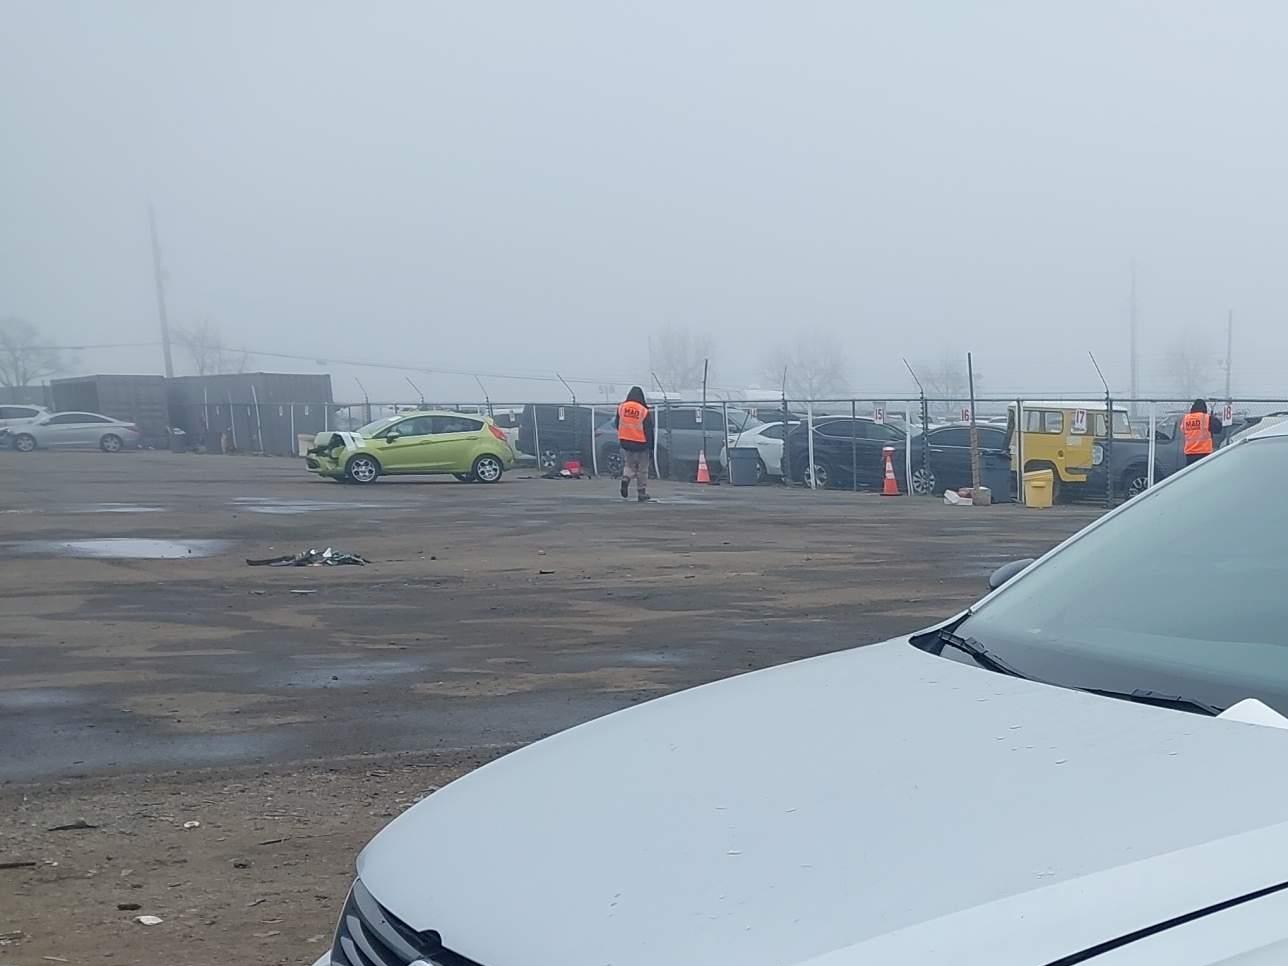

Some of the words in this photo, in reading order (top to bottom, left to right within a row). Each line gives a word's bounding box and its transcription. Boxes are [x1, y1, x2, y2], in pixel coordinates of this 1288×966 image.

[874, 408, 884, 421] 15
[960, 409, 969, 422] 16
[1075, 410, 1085, 422] 17
[1223, 405, 1232, 421] 18
